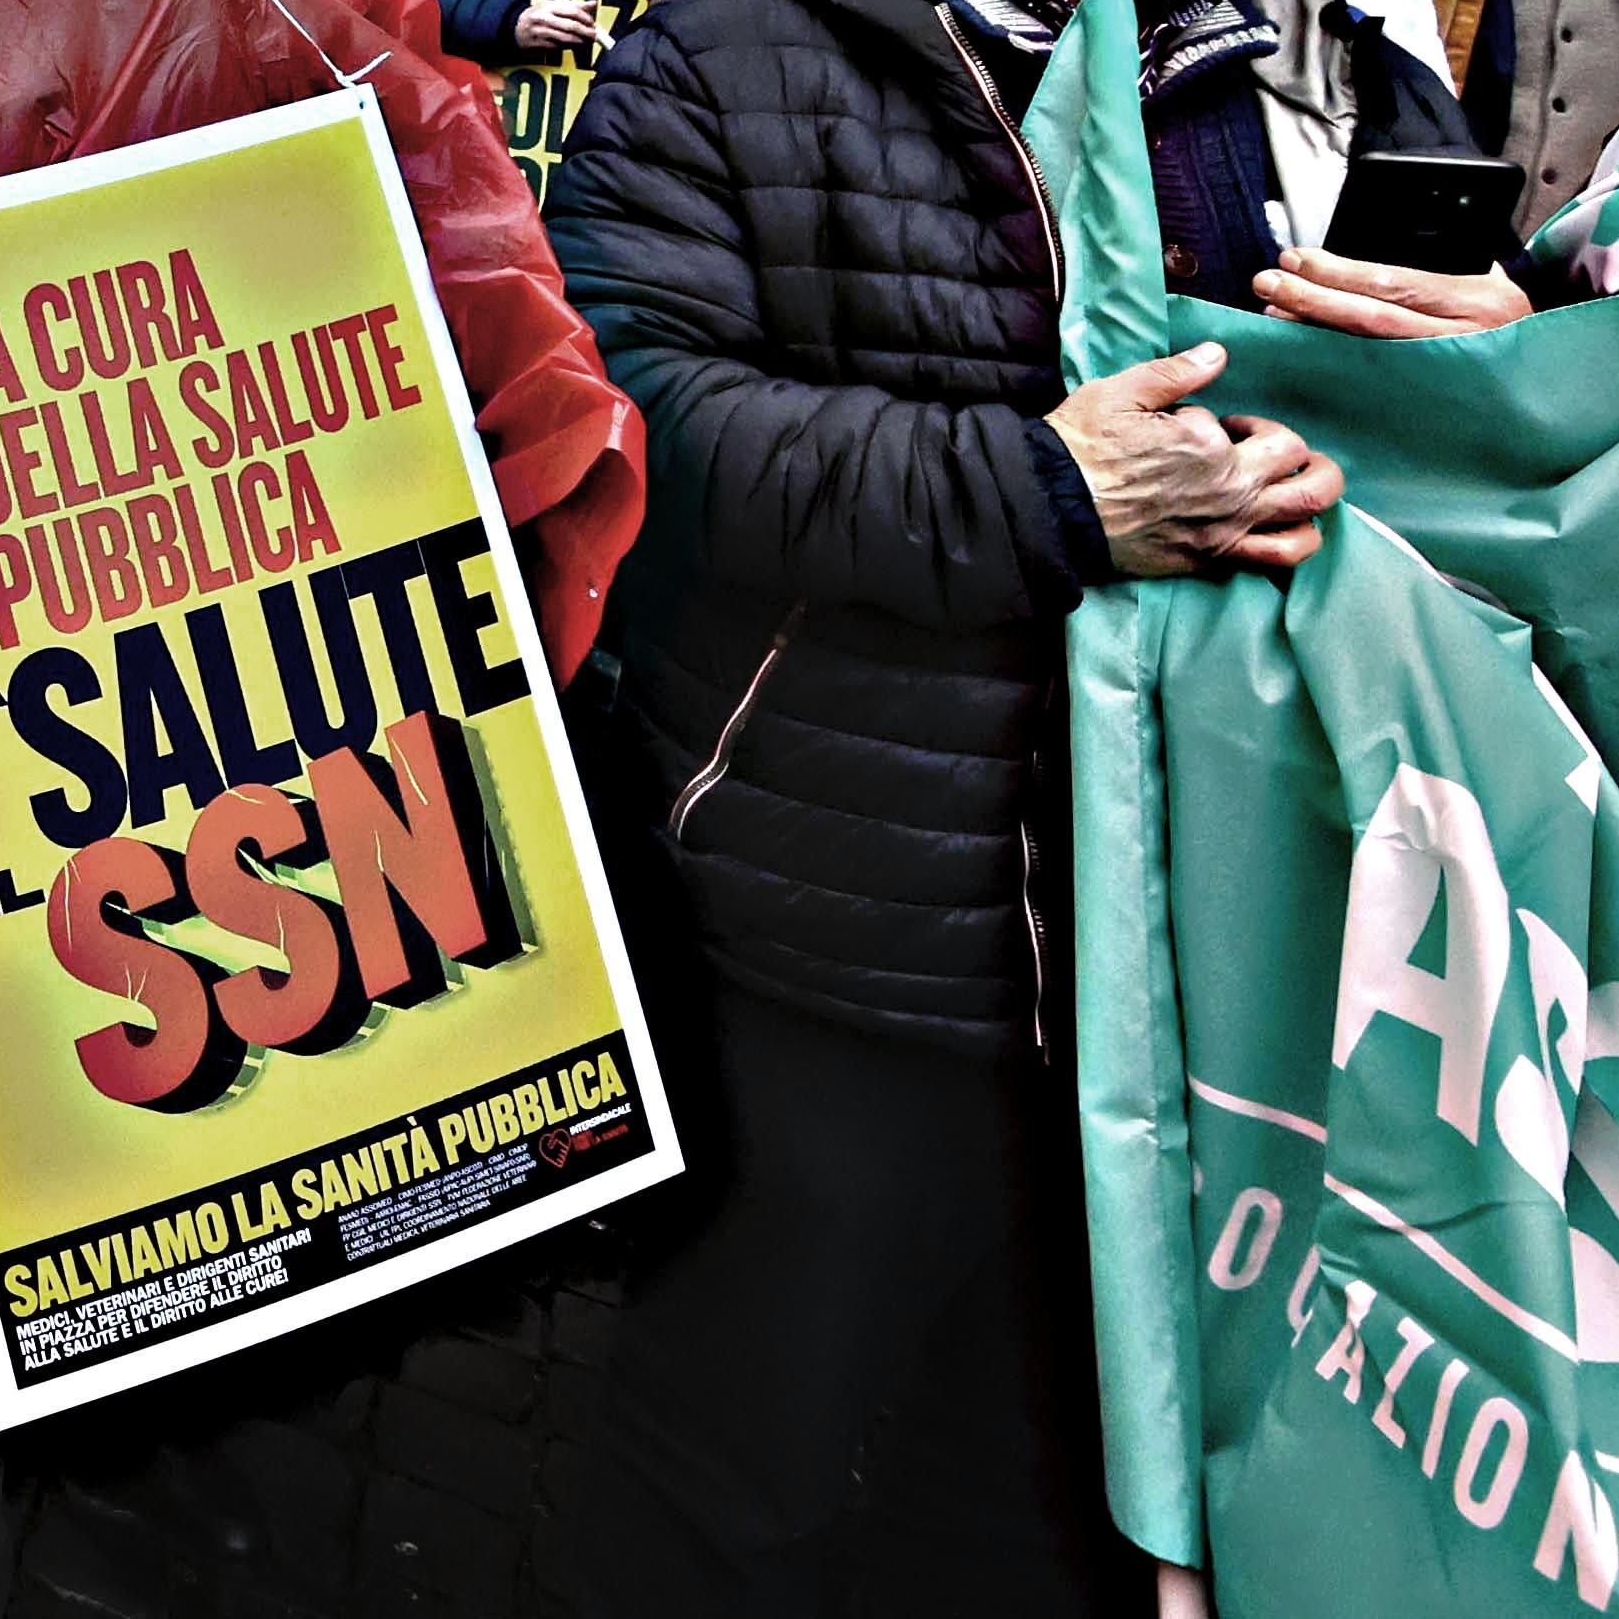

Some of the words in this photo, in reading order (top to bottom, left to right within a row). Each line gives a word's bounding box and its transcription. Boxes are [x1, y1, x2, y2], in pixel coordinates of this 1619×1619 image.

[23, 248, 224, 390] CURA
[178, 303, 422, 469] SALUTE
[7, 515, 532, 848] SALUTE
[46, 711, 502, 1108] SSN
[2, 1192, 232, 1327] SALVIAMO
[231, 1181, 285, 1243] LA
[284, 1114, 434, 1222] SANITÀ
[436, 1049, 627, 1166] PUBBLICA
[15, 1306, 75, 1344] MEDICI,
[75, 1277, 161, 1324] VETERINARI
[163, 1276, 175, 1292] E
[175, 1249, 246, 1289] DIRIGENTI
[248, 1227, 312, 1263] SANITARI
[19, 1337, 36, 1355] IN
[38, 1316, 95, 1351] PIAZZA
[96, 1306, 128, 1331] PER
[129, 1277, 210, 1322] DIFENDERE
[211, 1274, 226, 1291] IL
[227, 1253, 283, 1286] DIRITTO
[22, 1344, 61, 1372] ALLA
[62, 1324, 119, 1360] SALUTE
[120, 1322, 132, 1339] E
[133, 1316, 149, 1335] IL
[150, 1295, 207, 1330] DIRITTO
[208, 1283, 244, 1309] ALLE
[244, 1267, 289, 1296] CURE!
